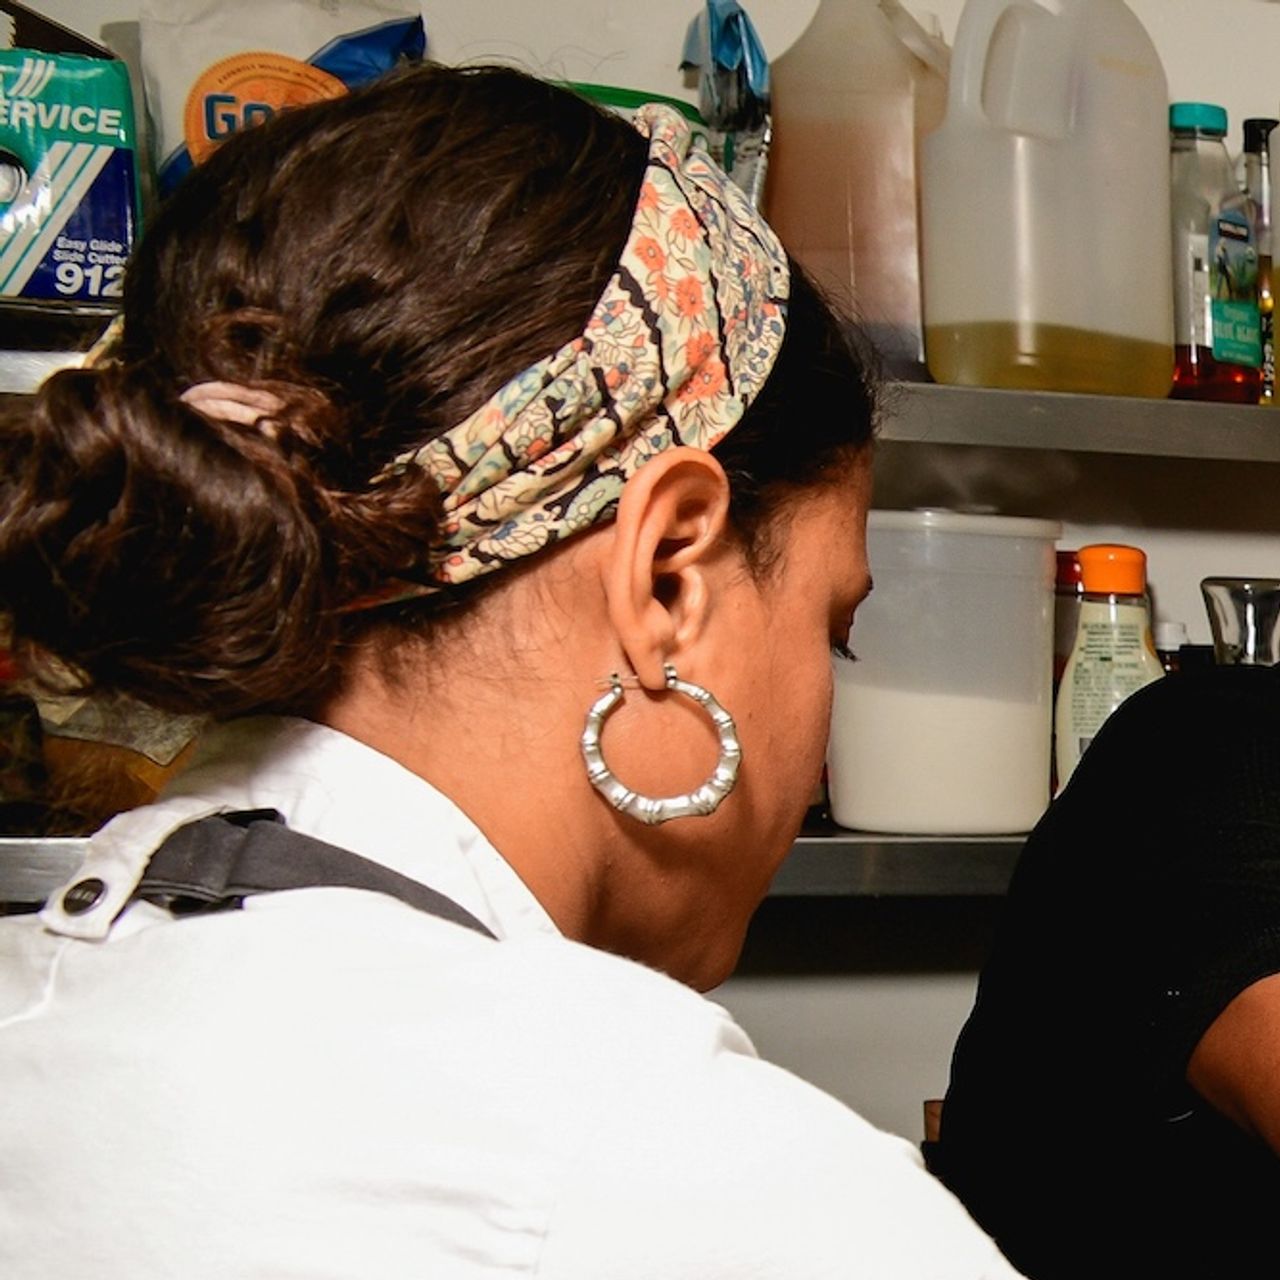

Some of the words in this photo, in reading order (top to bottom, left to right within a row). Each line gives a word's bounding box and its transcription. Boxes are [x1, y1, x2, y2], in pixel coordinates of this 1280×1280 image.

[56, 236, 87, 252] Easy
[90, 239, 123, 253] Glide
[54, 262, 127, 297] 912
